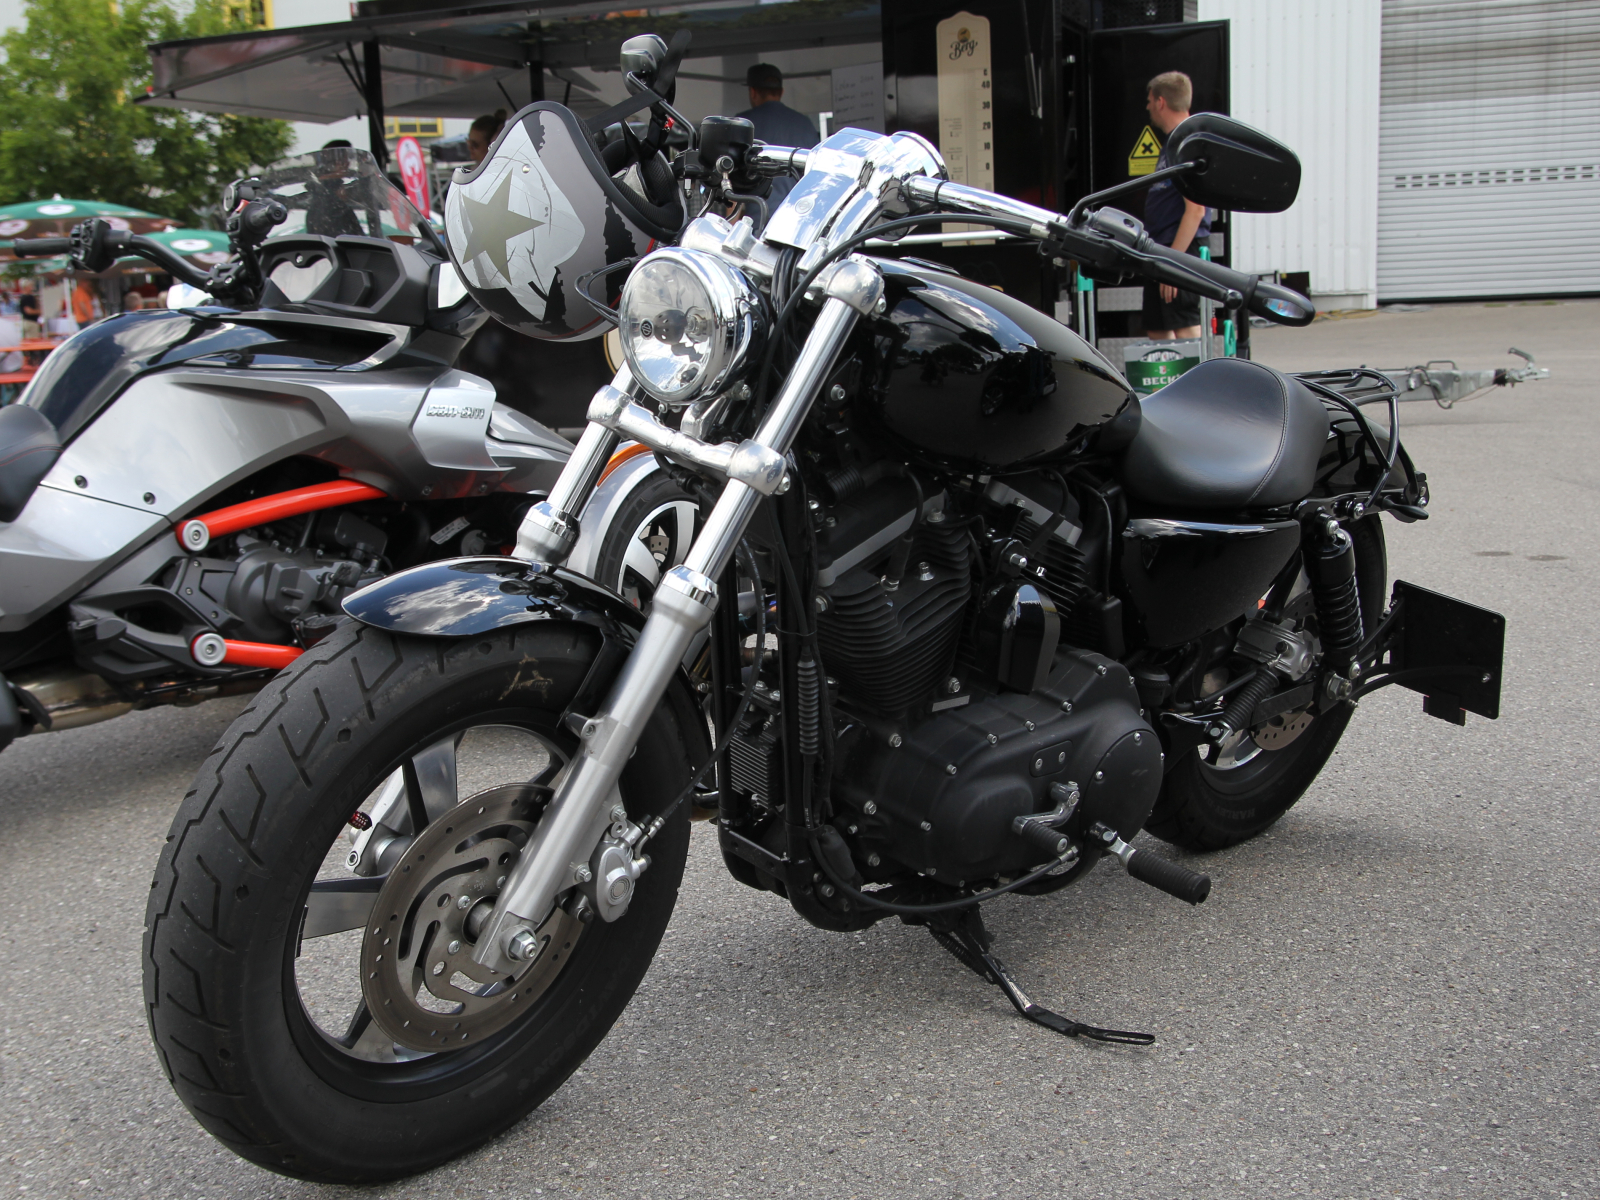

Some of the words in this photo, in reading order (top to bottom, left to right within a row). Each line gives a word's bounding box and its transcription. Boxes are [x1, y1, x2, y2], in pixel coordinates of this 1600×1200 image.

[949, 40, 978, 60] Berg
[981, 81, 990, 89] 40
[982, 101, 990, 109] 30
[983, 121, 991, 130] 20
[984, 142, 990, 150] 10
